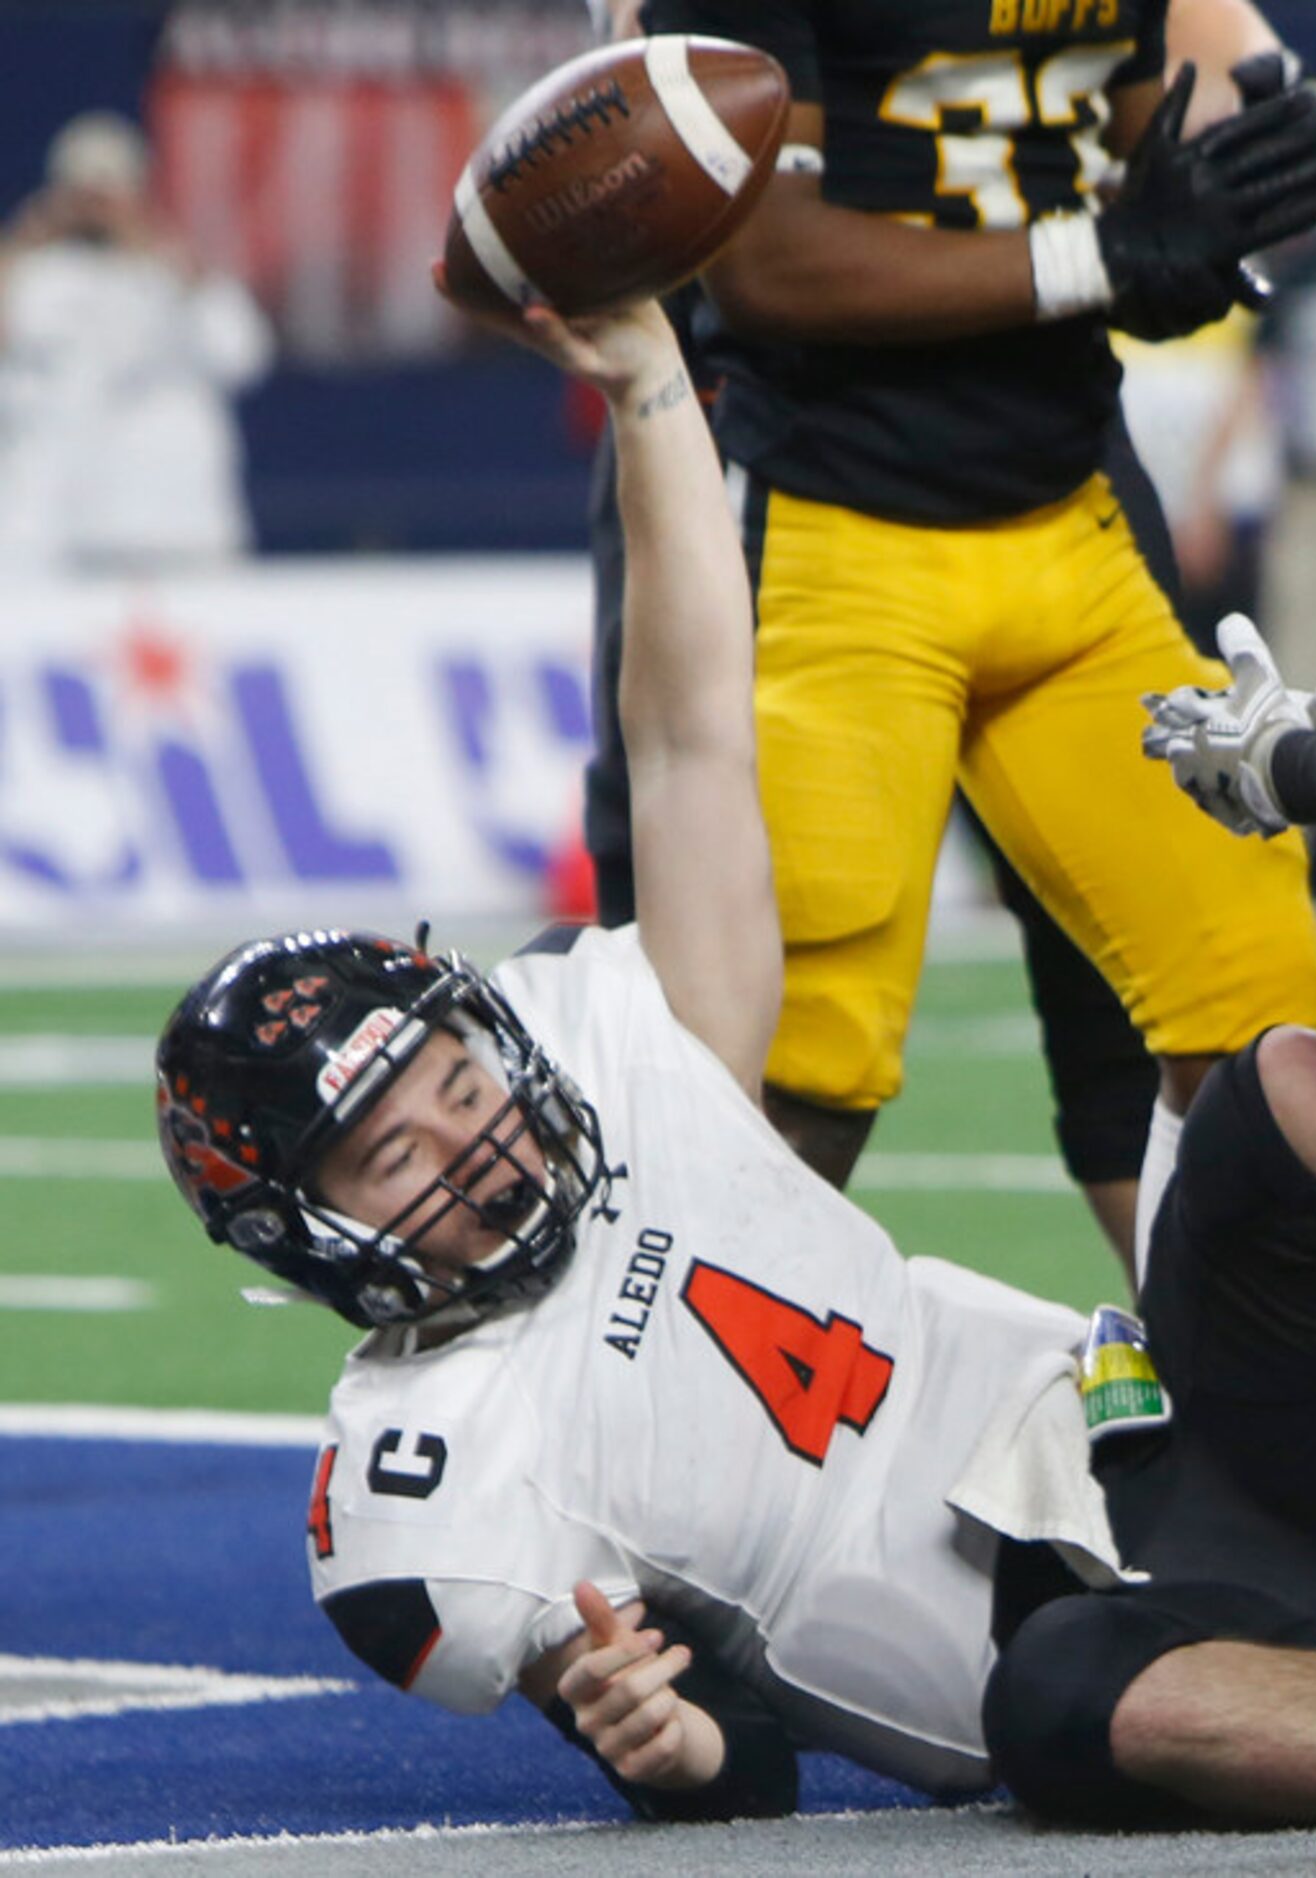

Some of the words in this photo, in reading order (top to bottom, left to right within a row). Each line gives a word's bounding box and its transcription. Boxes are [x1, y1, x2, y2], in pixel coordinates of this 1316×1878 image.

[523, 150, 650, 235] Wilson
[603, 1227, 674, 1361] ALEDO
[678, 1255, 895, 1469] 4
[366, 1427, 448, 1501] C
